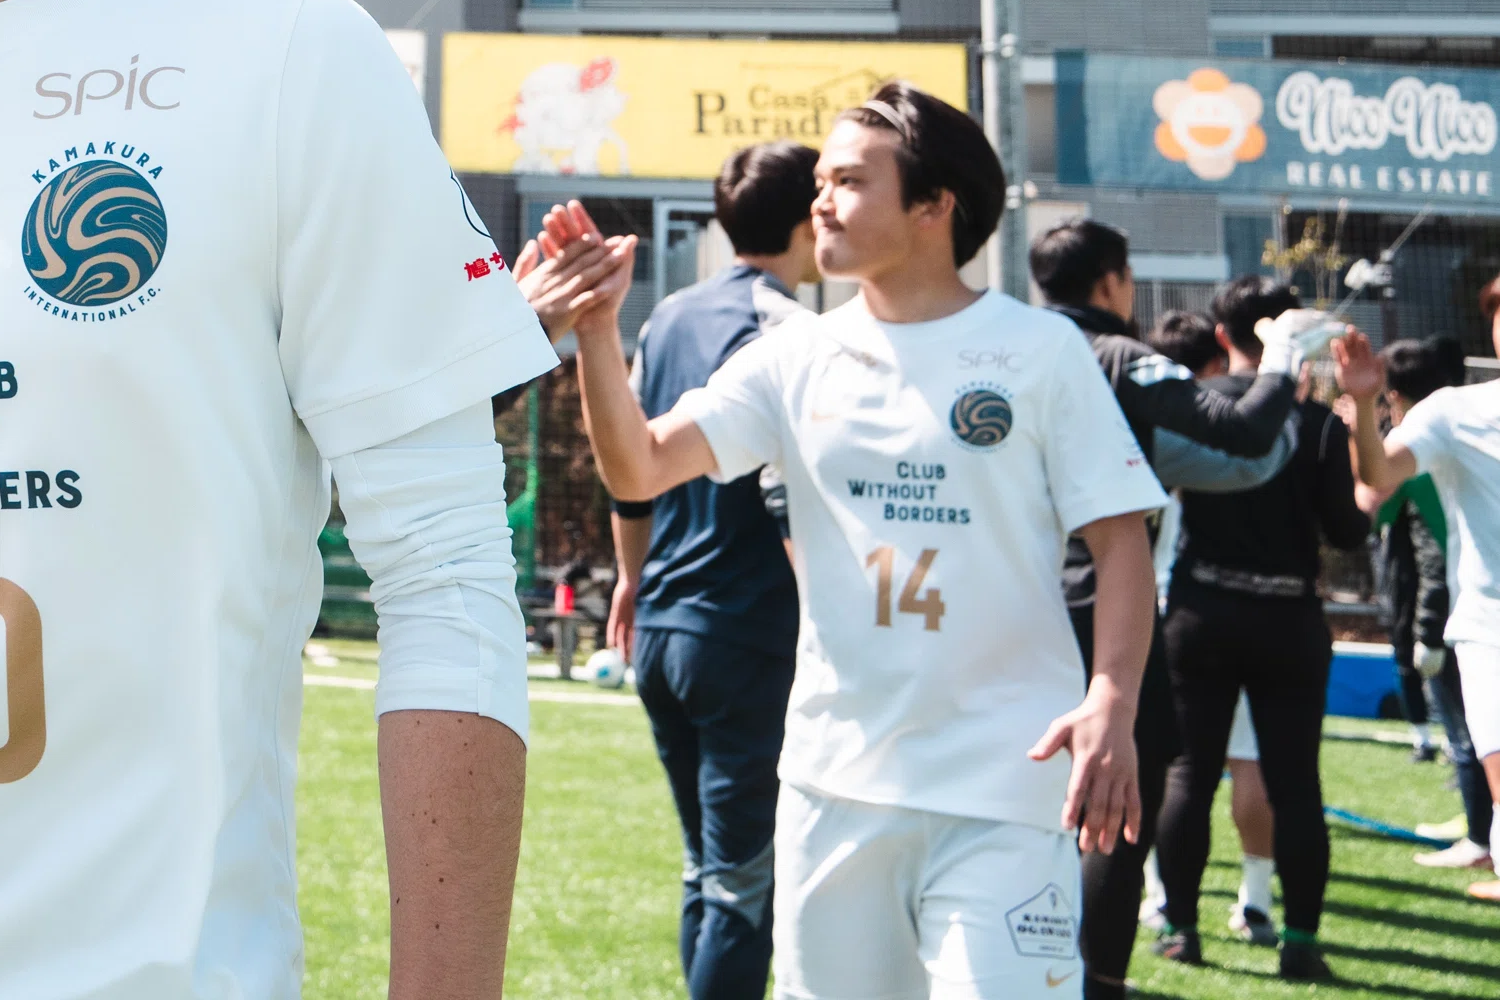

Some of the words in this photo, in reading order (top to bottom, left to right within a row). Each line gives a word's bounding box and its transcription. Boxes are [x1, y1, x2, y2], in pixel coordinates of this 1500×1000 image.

[692, 90, 825, 137] Parad
[31, 141, 164, 184] KAMAKURA
[1287, 161, 1365, 190] REAL
[1377, 166, 1493, 197] ESTATE
[23, 286, 136, 322] INTERNATIONAL
[896, 461, 946, 480] CLUB
[847, 480, 937, 500] WITHOUT
[883, 503, 971, 525] BORDERS
[865, 546, 946, 632] 14
